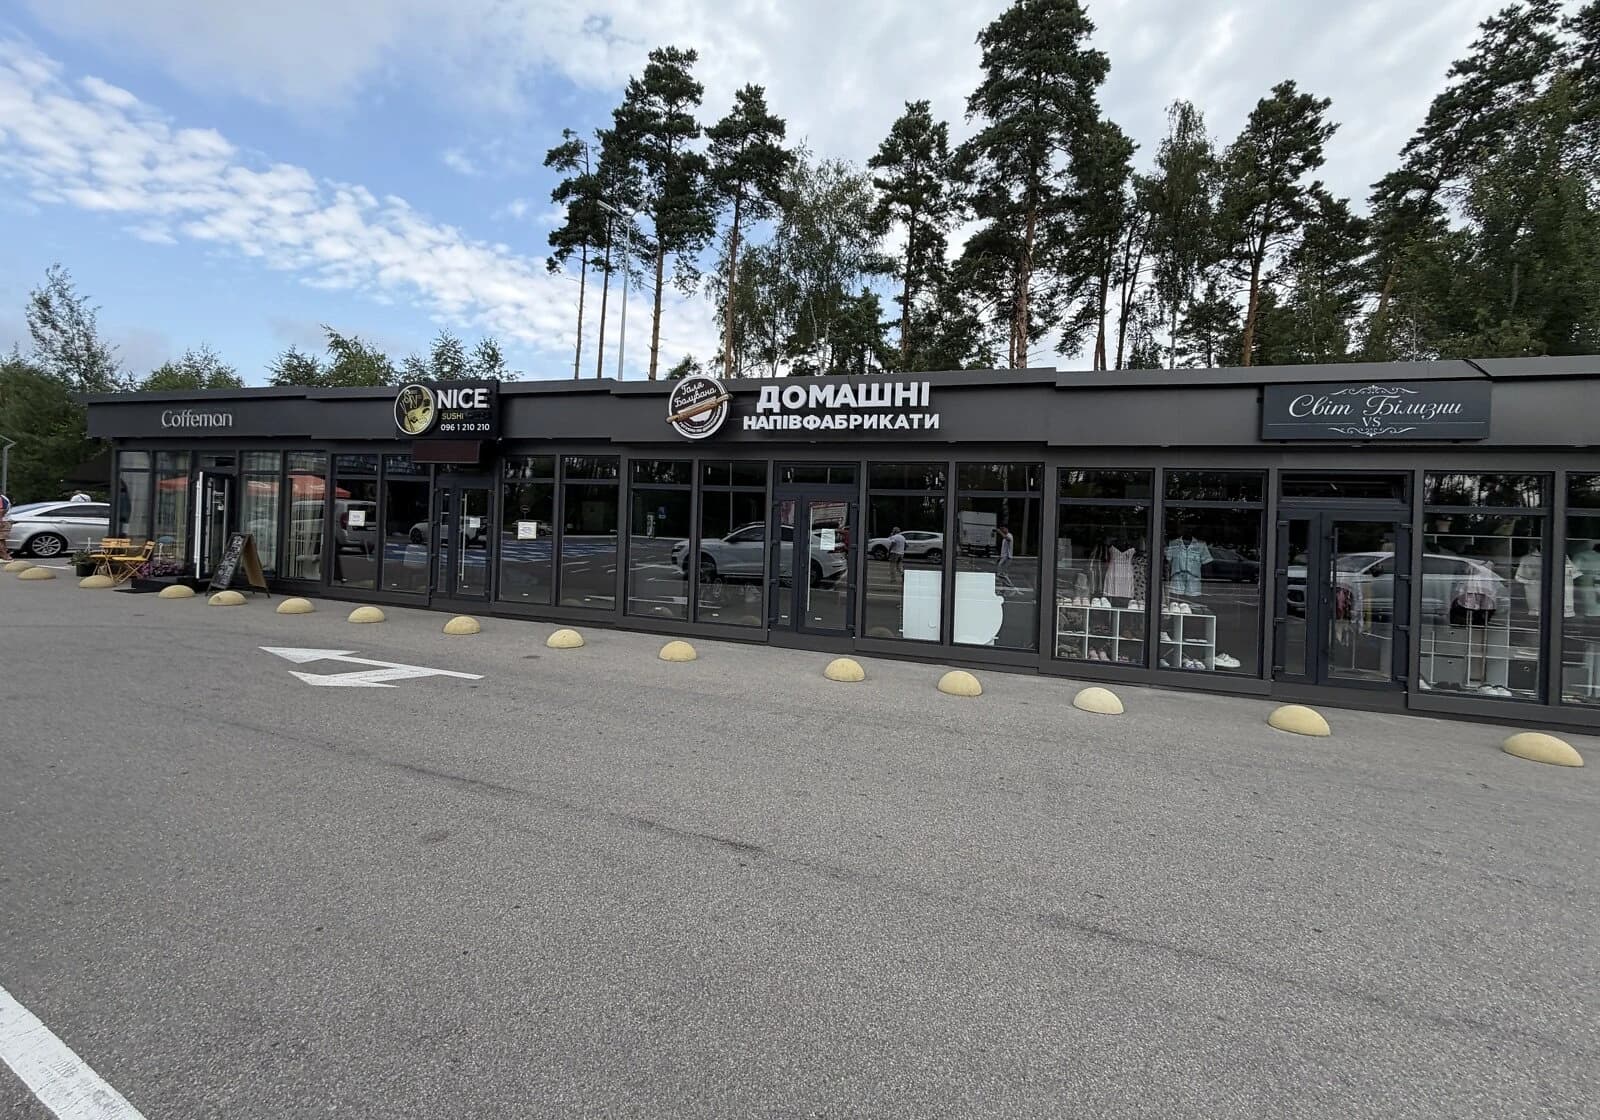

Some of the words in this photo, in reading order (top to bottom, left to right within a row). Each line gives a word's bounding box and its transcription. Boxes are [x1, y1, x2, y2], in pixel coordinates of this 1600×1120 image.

[681, 381, 705, 395] Галя
[437, 388, 490, 409] NICE
[756, 381, 930, 413] ДОМАШНІ
[1288, 394, 1354, 417] Світ
[1362, 395, 1463, 420] Білизни
[161, 409, 233, 428] Coffeman
[441, 412, 464, 420] SUSHI
[743, 413, 940, 430] НАПІВФАБРИКАТИ
[1362, 416, 1382, 427] VS
[440, 423, 455, 431] 096
[462, 423, 475, 431] 210
[477, 423, 490, 431] 210
